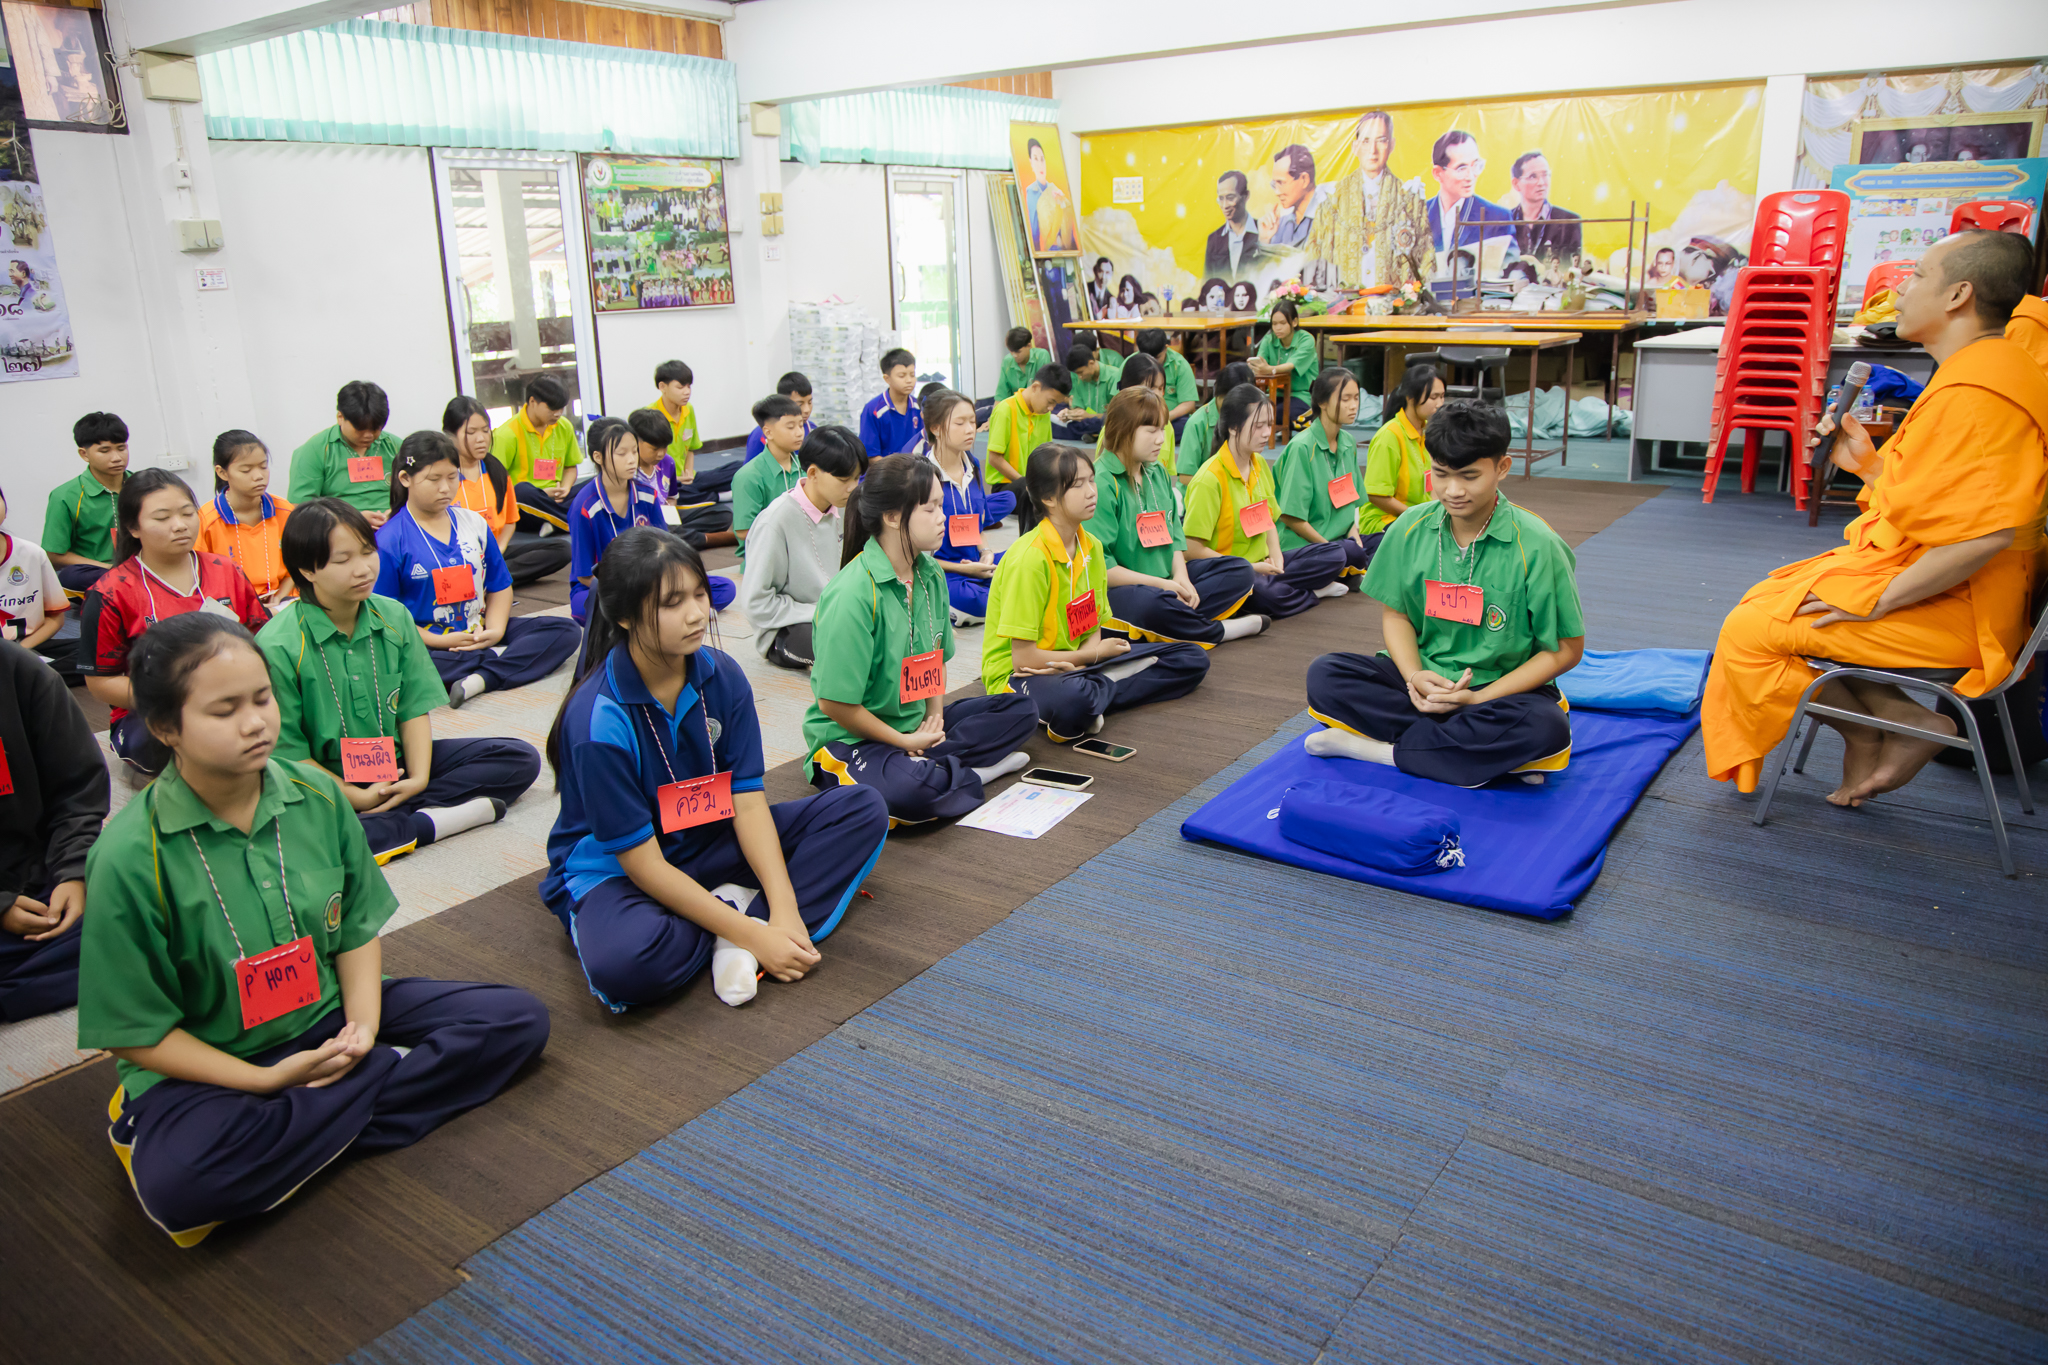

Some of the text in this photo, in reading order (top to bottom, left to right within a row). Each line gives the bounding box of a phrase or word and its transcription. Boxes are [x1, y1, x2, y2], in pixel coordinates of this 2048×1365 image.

[903, 666, 941, 692] ใบเตย
[346, 744, 392, 769] ขนมผิง
[676, 785, 716, 817] ครีม
[265, 965, 299, 991] HOM
